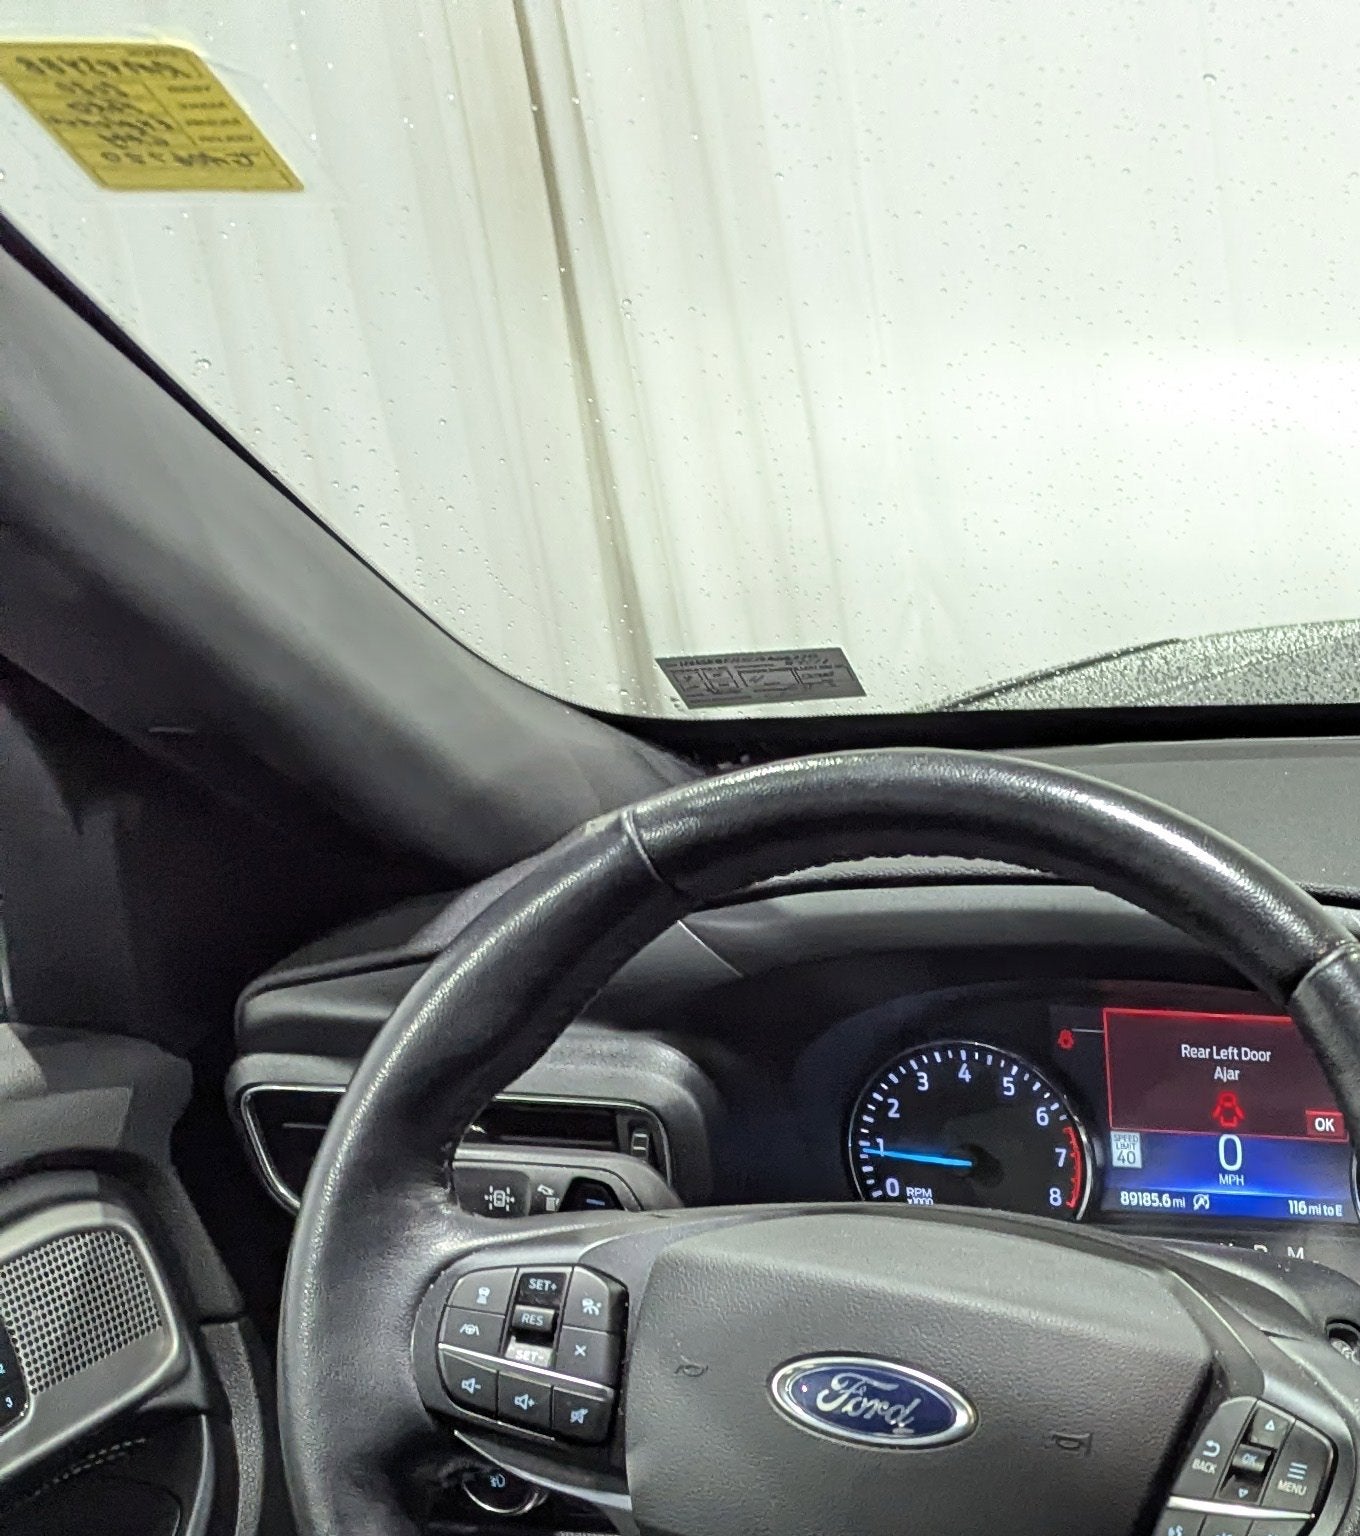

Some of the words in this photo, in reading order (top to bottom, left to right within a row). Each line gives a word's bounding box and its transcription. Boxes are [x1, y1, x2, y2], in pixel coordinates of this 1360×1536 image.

[1181, 1044, 1210, 1060] Rear
[1213, 1046, 1239, 1061] Left
[1241, 1047, 1272, 1062] Door
[917, 1071, 930, 1091] 3
[958, 1063, 971, 1083] 4
[1214, 1066, 1240, 1082] Ajar
[1003, 1077, 1015, 1096] 5
[887, 1098, 901, 1118] 2
[1036, 1106, 1049, 1126] 6
[1315, 1117, 1335, 1132] OK
[876, 1138, 885, 1157] 1
[1113, 1133, 1139, 1144] SPEED
[1115, 1142, 1136, 1151] LIMIT
[1055, 1148, 1067, 1168] 7
[1116, 1150, 1136, 1165] 40
[1218, 1133, 1243, 1171] 0
[886, 1178, 900, 1197] 0
[1219, 1173, 1245, 1187] MPH
[906, 1186, 933, 1198] RPM
[1049, 1188, 1062, 1207] 8
[1120, 1191, 1171, 1209] 89185.6
[1172, 1195, 1186, 1208] mi
[1288, 1199, 1307, 1216] 116
[1308, 1202, 1321, 1216] mi
[1323, 1203, 1334, 1217] to
[1336, 1203, 1343, 1217] E
[521, 1312, 544, 1327] RES
[815, 1371, 923, 1435] Ford
[1192, 1458, 1218, 1475] BACK
[1277, 1480, 1308, 1497] MENU
